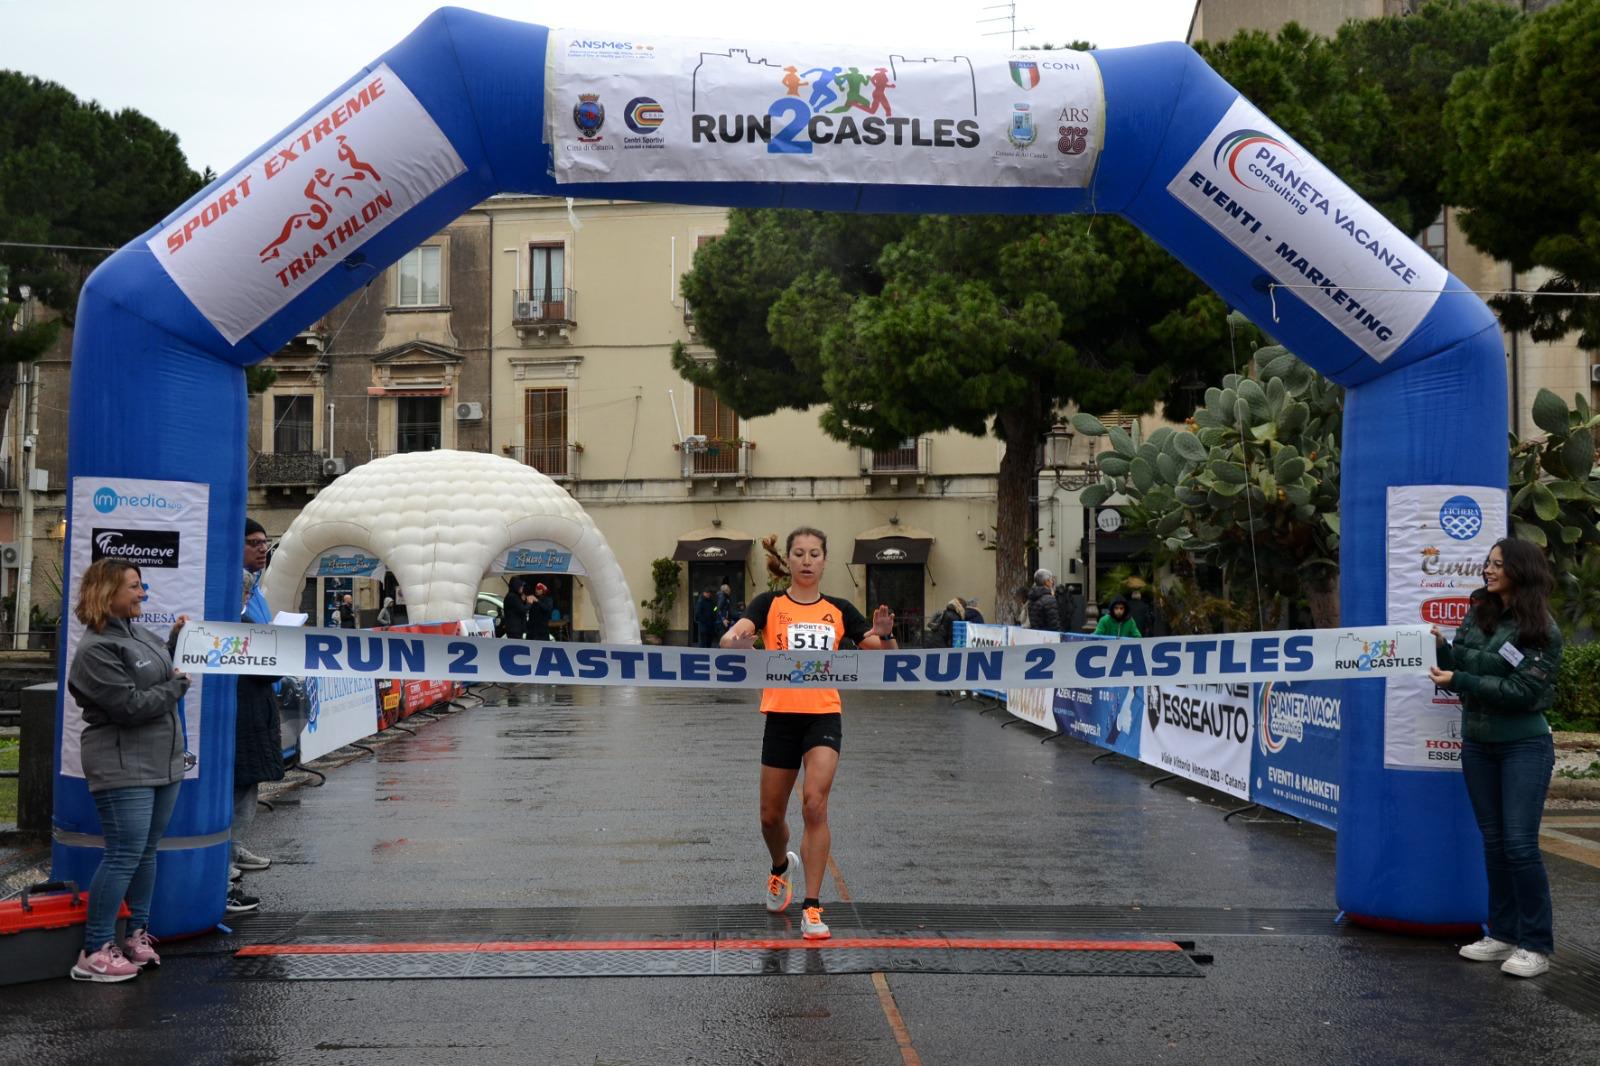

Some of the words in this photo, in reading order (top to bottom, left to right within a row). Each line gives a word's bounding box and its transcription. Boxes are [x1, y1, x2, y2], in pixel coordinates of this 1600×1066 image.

[1042, 62, 1080, 71] CONI
[692, 97, 981, 154] RUN2CASTLES
[1059, 107, 1089, 123] ARS
[166, 174, 252, 255] SPORT
[263, 77, 386, 181] EXTREME
[1248, 162, 1309, 216] consulting
[1255, 146, 1330, 216] PIANETA
[1335, 208, 1417, 286] VACANZE
[275, 189, 393, 288] TRIATHLON
[1188, 170, 1263, 236] EVENTI
[1275, 241, 1394, 342] MARKETING
[131, 612, 177, 624] PRESA
[182, 649, 278, 668] RUN2CASTLES
[304, 633, 426, 673] RUN
[446, 641, 479, 675] 2
[498, 644, 748, 683] CASTLES
[794, 632, 830, 651] 511
[882, 650, 1004, 683] RUN
[1024, 647, 1057, 681] 2
[1074, 635, 1315, 680] CASTLES
[766, 669, 858, 684] RUN2CASTLES
[1335, 654, 1423, 672] RUN2CASTLES
[1162, 692, 1249, 744] ESSEAUTO
[1224, 773, 1247, 792] Catania
[1268, 766, 1294, 788] EVENTI
[1295, 773, 1301, 790] &
